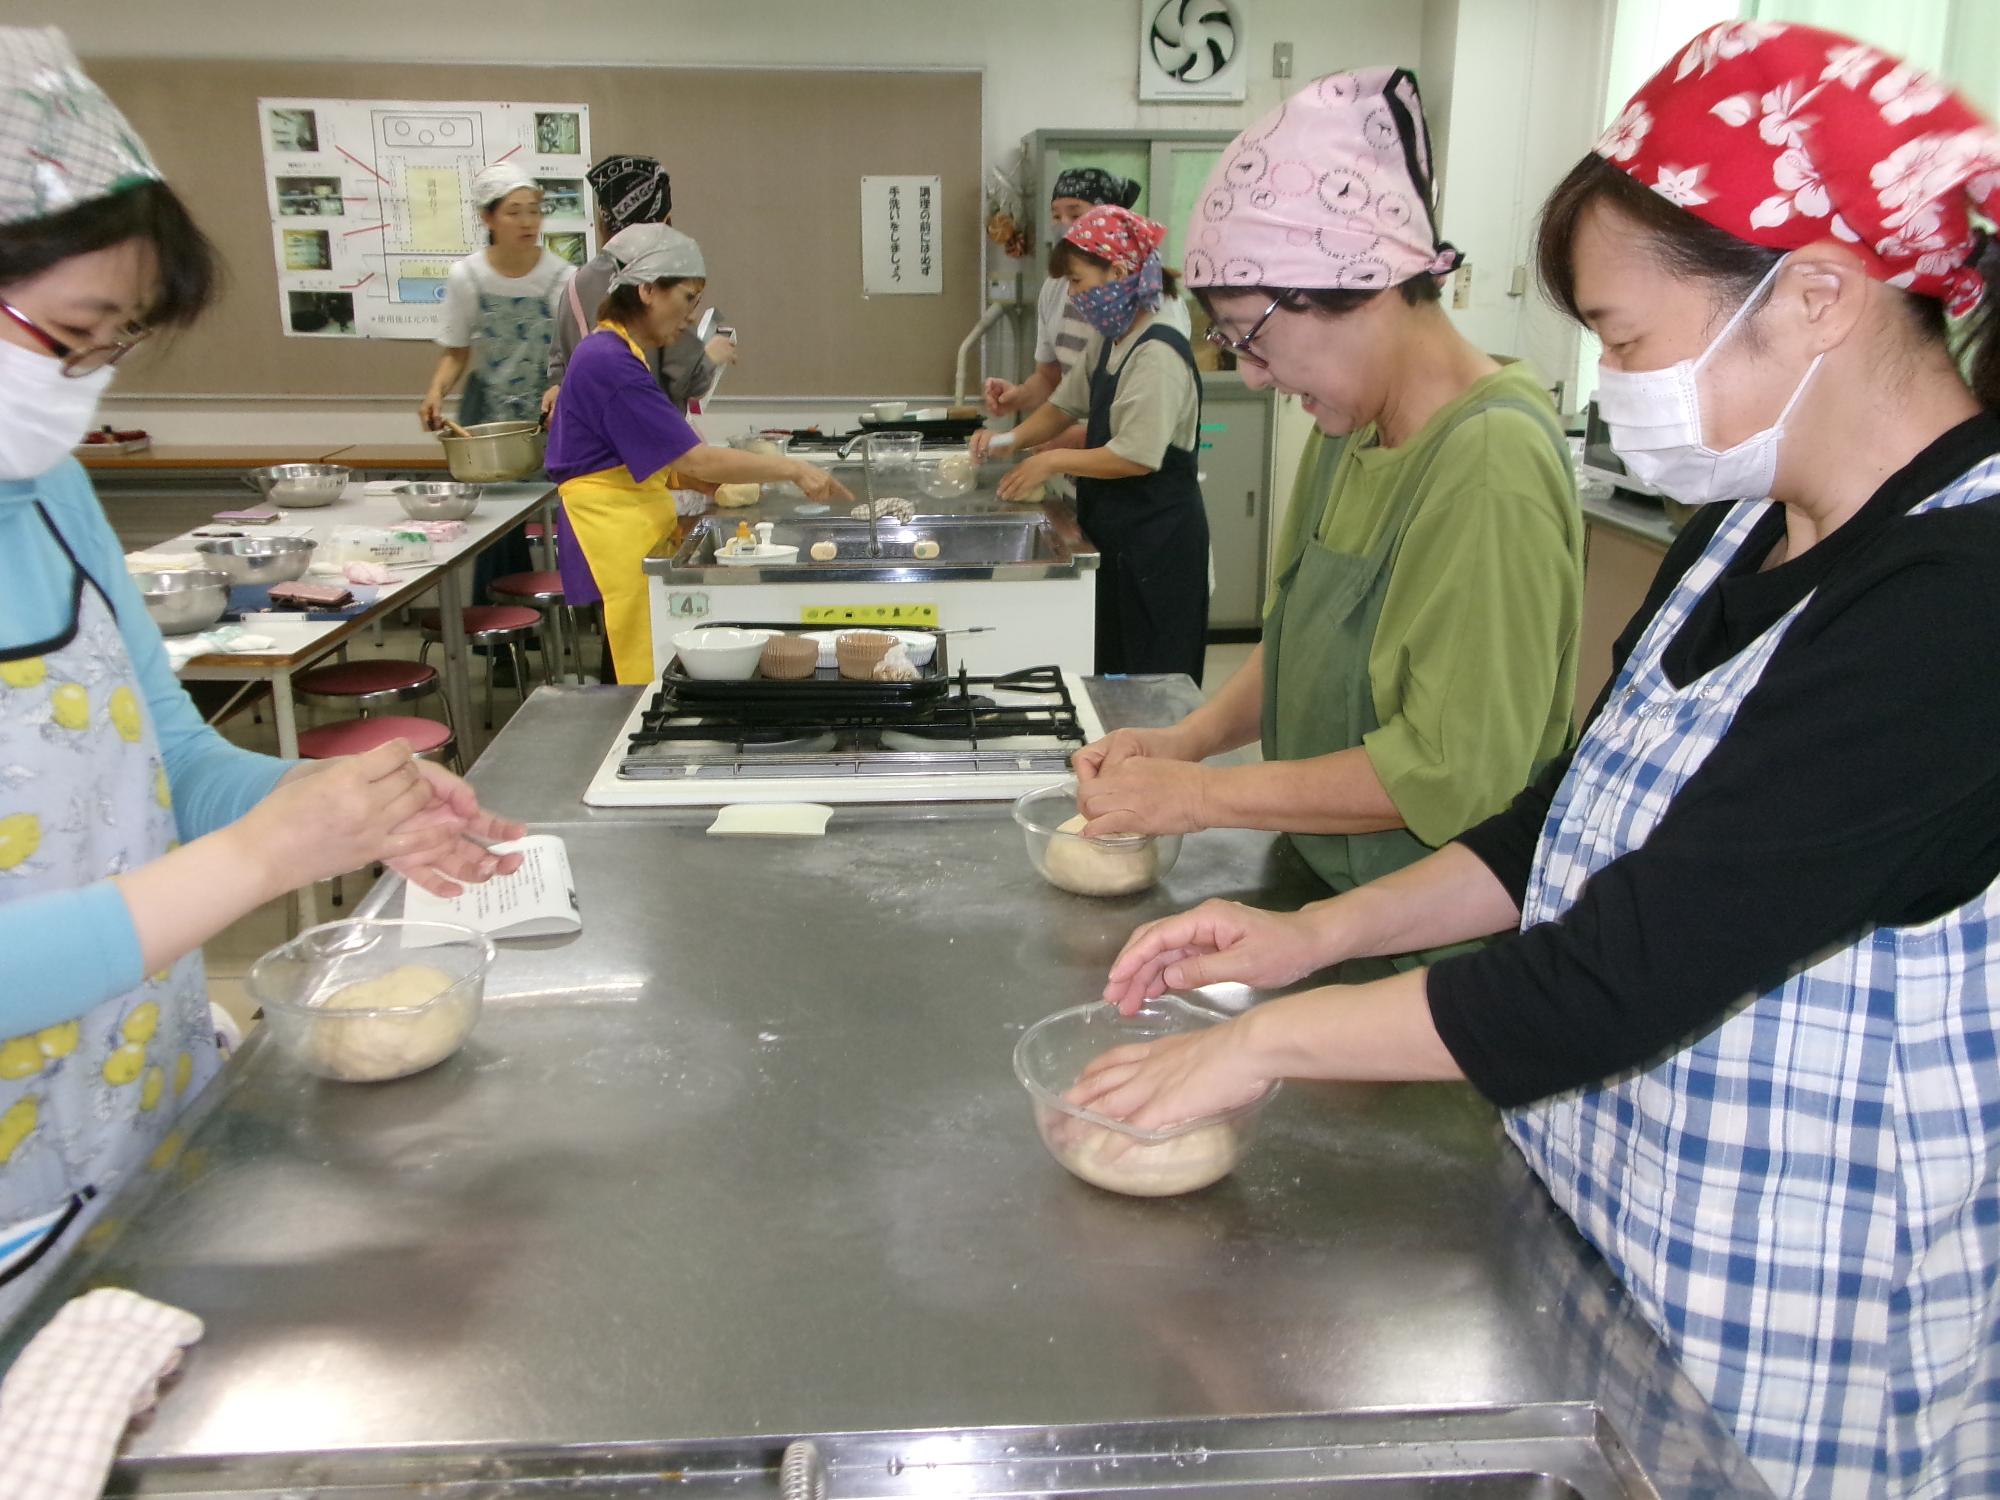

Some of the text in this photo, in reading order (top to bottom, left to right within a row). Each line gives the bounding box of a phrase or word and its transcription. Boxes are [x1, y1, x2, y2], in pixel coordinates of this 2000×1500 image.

[889, 186, 901, 282] 手洗いをしましょう
[920, 186, 931, 276] 調理の前には必ず
